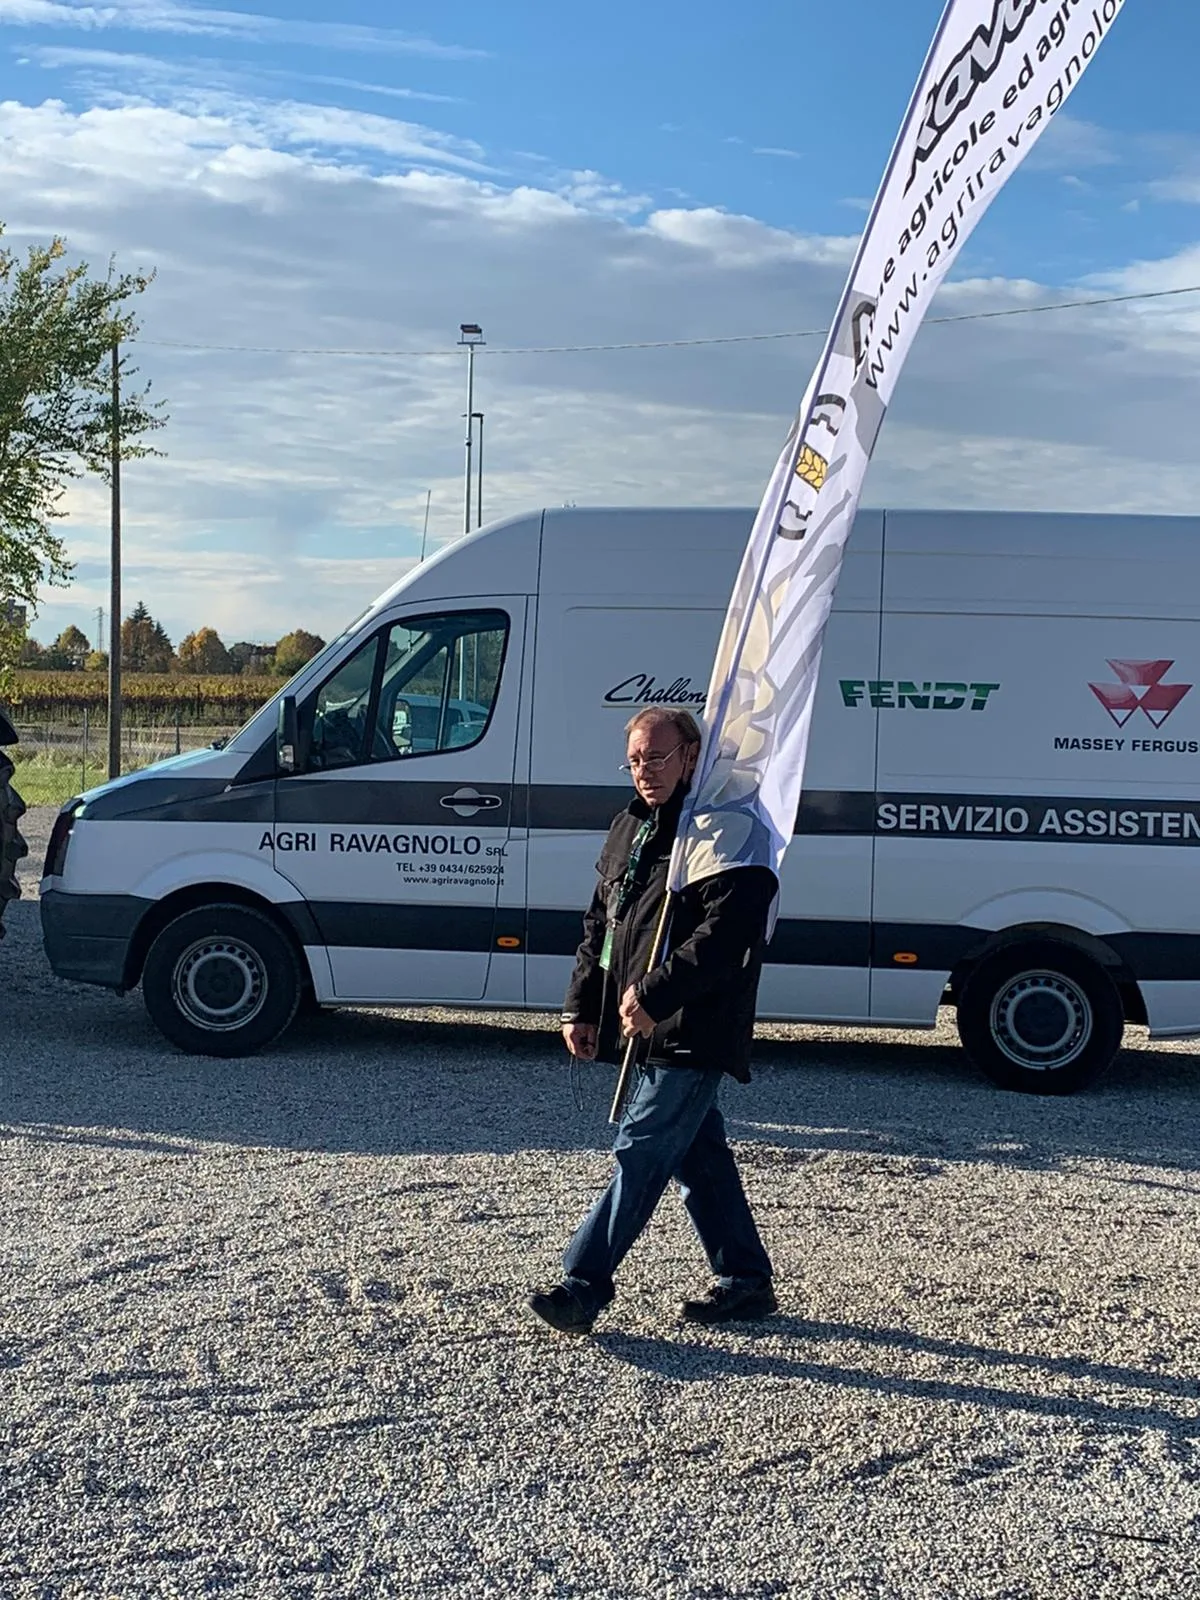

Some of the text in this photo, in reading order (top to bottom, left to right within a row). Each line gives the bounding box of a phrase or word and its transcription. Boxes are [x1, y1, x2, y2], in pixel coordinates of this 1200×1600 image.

[898, 0, 1080, 256] agricole ed agr
[865, 0, 1123, 389] www.agriravagnolo
[838, 680, 1000, 711] FENDT
[1053, 737, 1125, 751] MASSEY
[876, 803, 1200, 838] SERVIZIO ASSISTEN
[258, 832, 508, 856] AGRI RAVAGNOLO SRL
[396, 862, 505, 875] TEL +39 0434/625924
[403, 876, 505, 887] www.agriravagnolo.it
